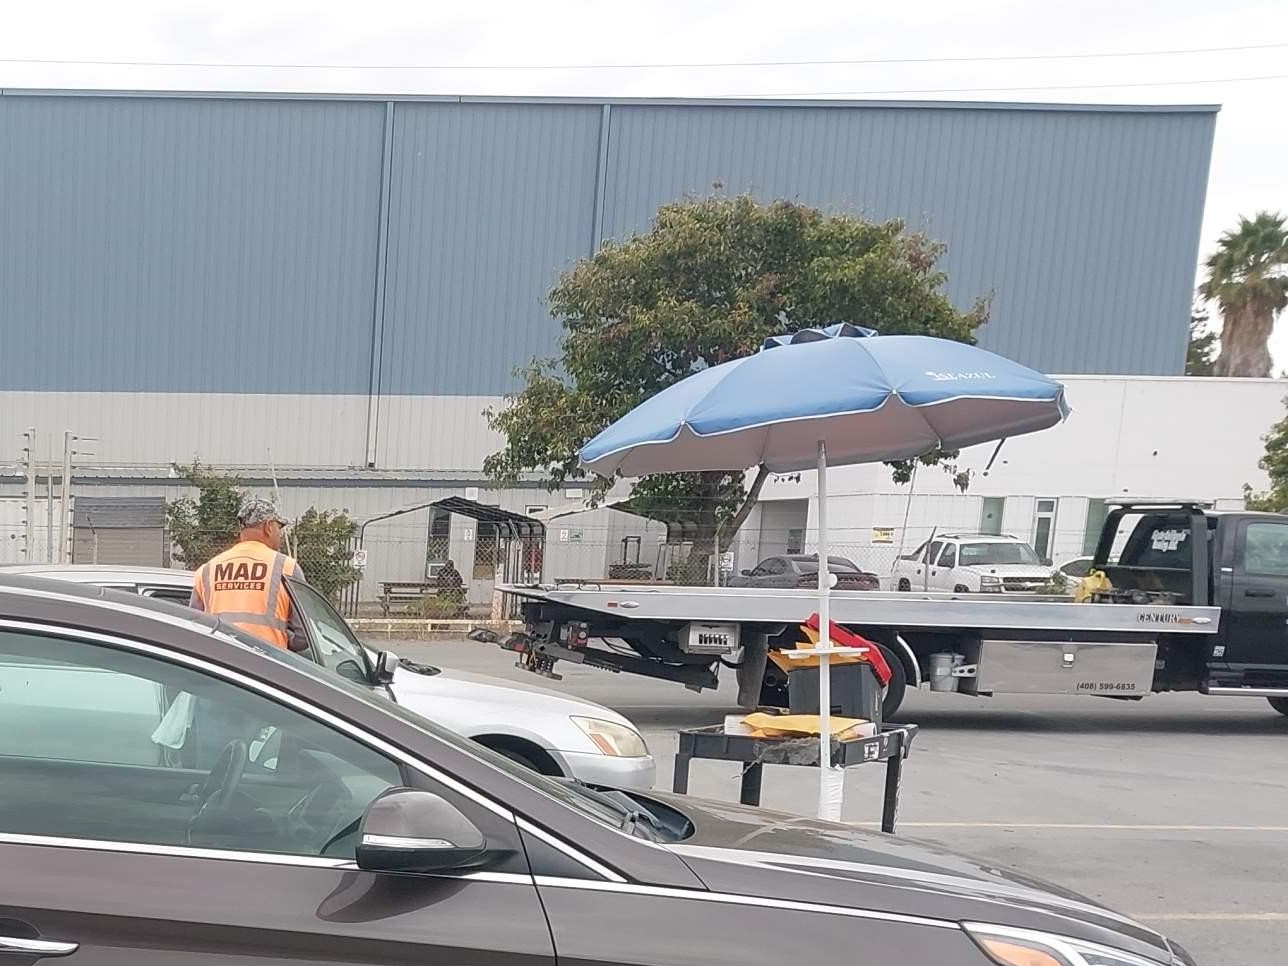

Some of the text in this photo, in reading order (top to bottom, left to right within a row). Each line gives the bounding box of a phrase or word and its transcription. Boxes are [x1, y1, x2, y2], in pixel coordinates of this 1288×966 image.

[214, 562, 268, 581] MAD
[215, 582, 263, 591] SERVICES
[1137, 612, 1180, 625] CENTURY
[1076, 682, 1097, 691] (408)
